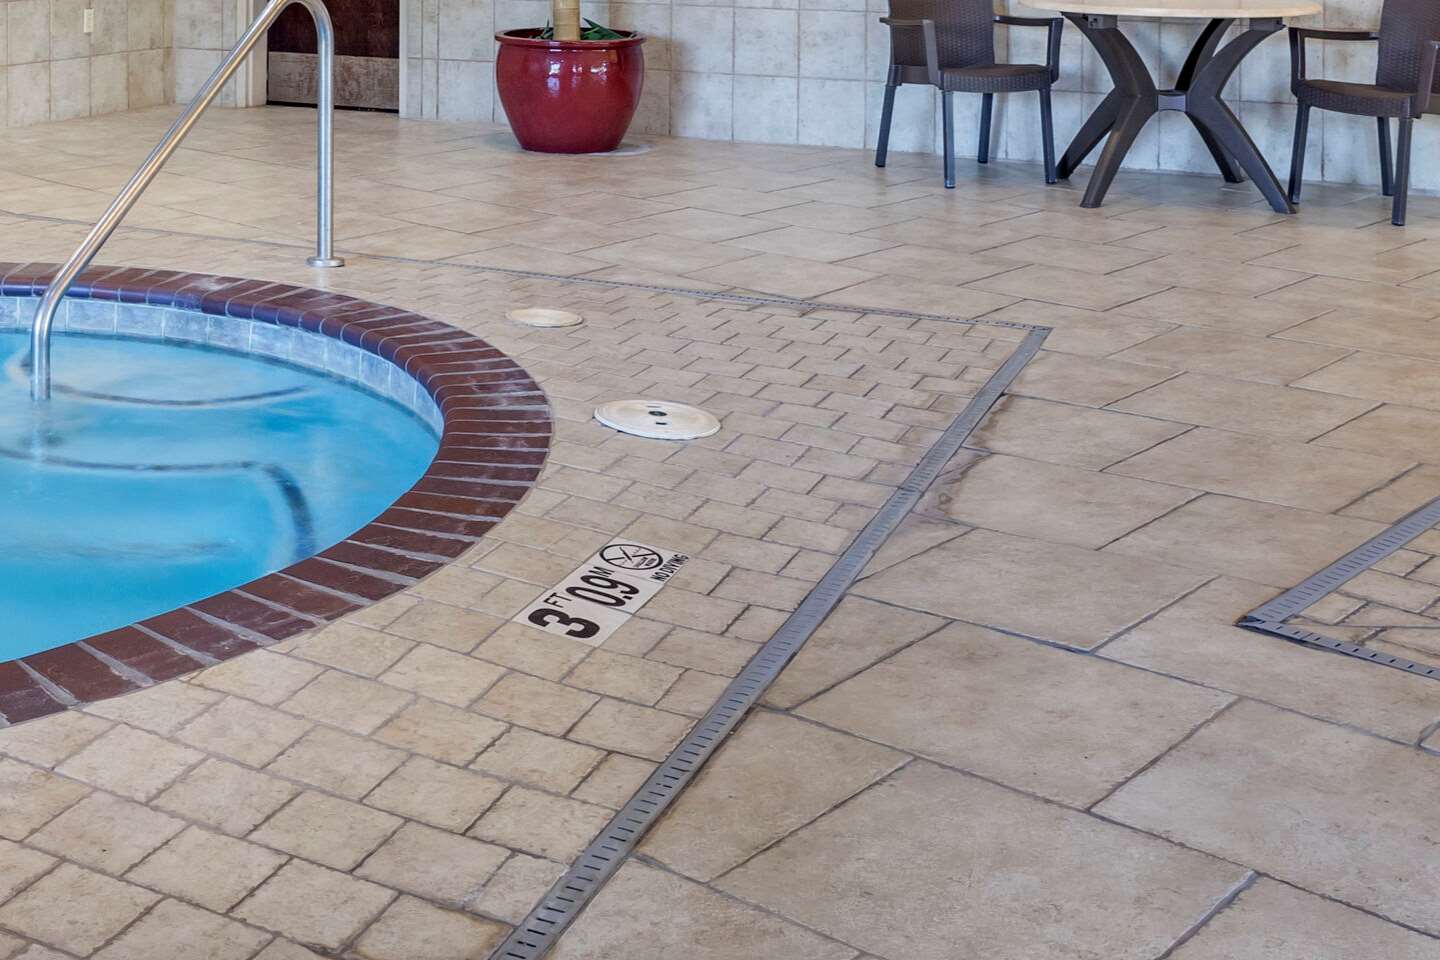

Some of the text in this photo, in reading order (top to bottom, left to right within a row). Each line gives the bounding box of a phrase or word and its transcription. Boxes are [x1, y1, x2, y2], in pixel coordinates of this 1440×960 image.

[659, 554, 689, 574] DIVING
[650, 571, 670, 581] NO
[527, 565, 640, 639] 3 FT 0.9 M
